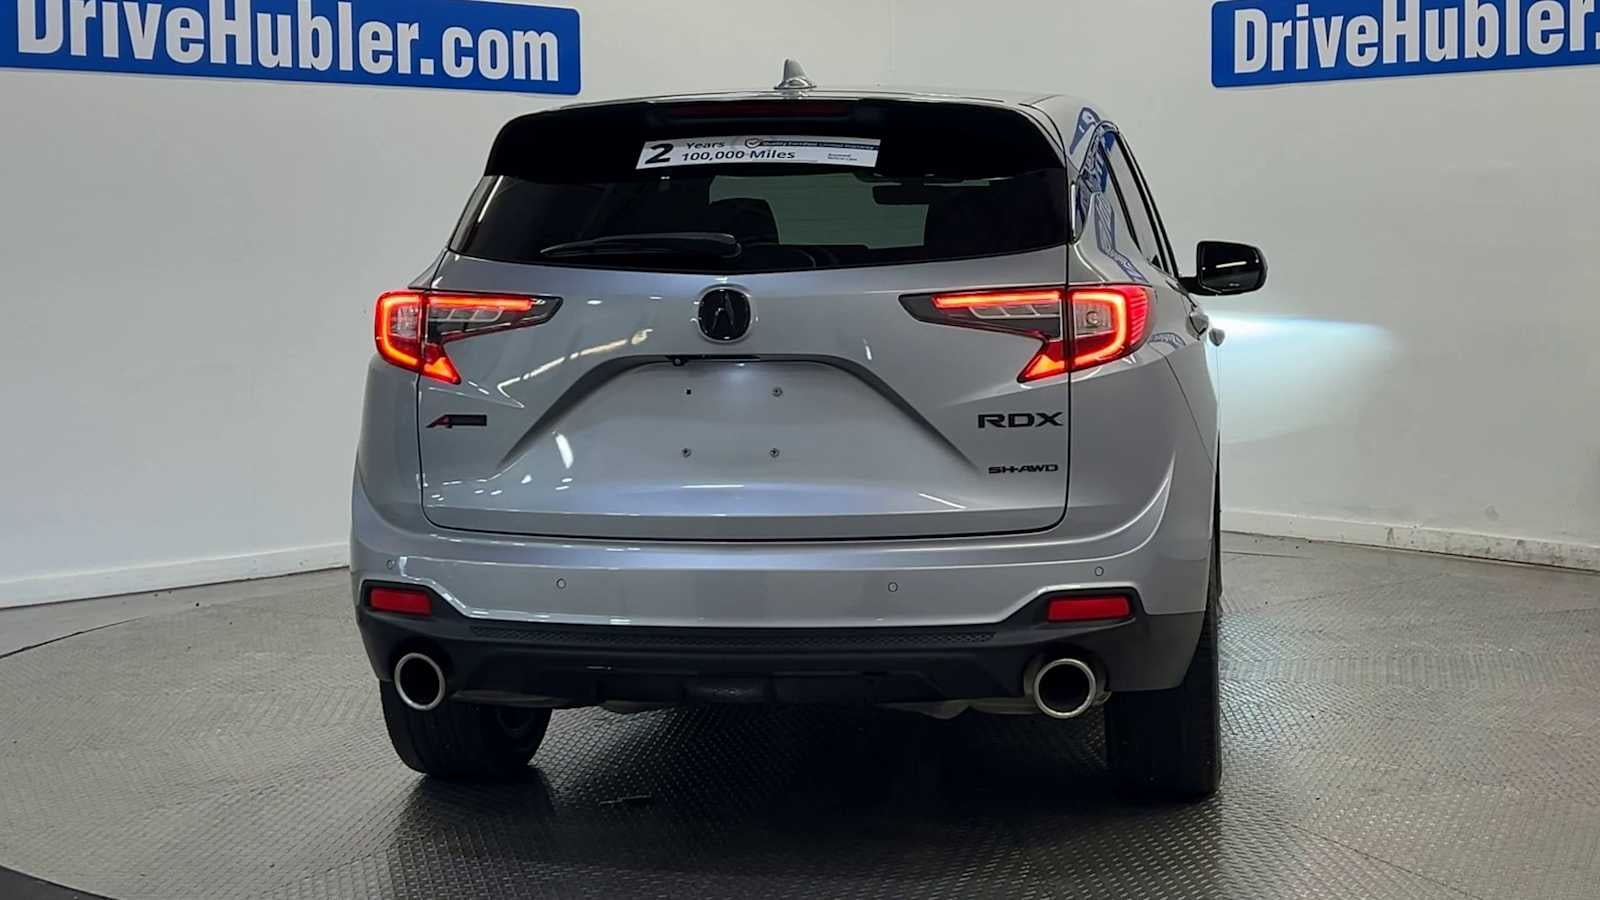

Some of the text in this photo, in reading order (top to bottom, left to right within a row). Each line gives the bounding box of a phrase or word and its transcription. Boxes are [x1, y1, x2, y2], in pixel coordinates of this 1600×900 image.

[18, 0, 559, 81] DriveHubler.com
[645, 142, 725, 164] 2 Years
[682, 150, 796, 161] 100,000 Miles
[978, 412, 1064, 428] RDX
[988, 464, 1059, 474] SH-AWD
